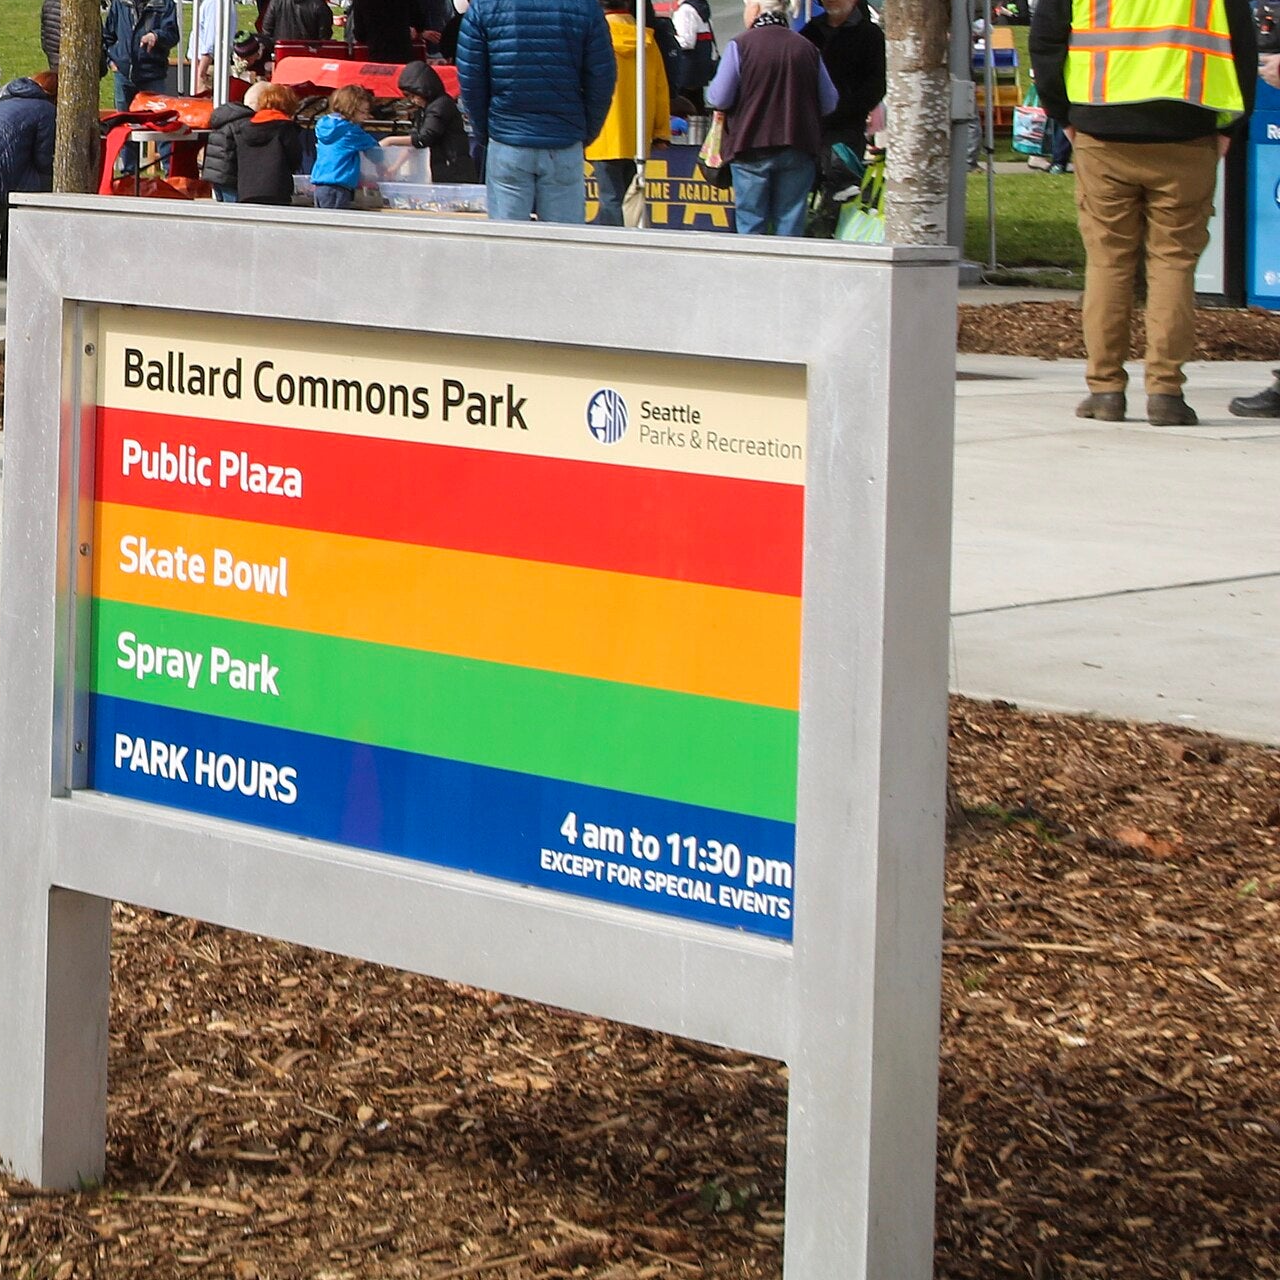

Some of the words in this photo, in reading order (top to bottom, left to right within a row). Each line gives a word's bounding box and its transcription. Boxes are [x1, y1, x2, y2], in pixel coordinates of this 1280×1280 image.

[124, 348, 242, 400] Ballard
[254, 360, 430, 420] Commons
[442, 378, 529, 431] Park
[641, 401, 701, 424] Seattle
[122, 438, 212, 487] Public
[219, 450, 302, 498] Plaza
[640, 424, 685, 448] Parks
[690, 429, 702, 449] &
[706, 431, 803, 460] Recreation
[120, 535, 206, 584] Skate
[214, 548, 288, 597] Bowl
[117, 631, 203, 689] Spray
[210, 646, 280, 696] Park
[114, 732, 188, 783] PARK
[195, 748, 298, 805] HOURS
[560, 812, 578, 844] 4
[582, 822, 624, 855] am
[630, 826, 660, 862] to
[666, 832, 741, 878] 11:30
[746, 855, 792, 888] pm
[540, 848, 604, 881] EXCEPT
[607, 862, 642, 889] FOR
[644, 870, 716, 905] SPECIAL
[718, 886, 791, 920] EVENTS
